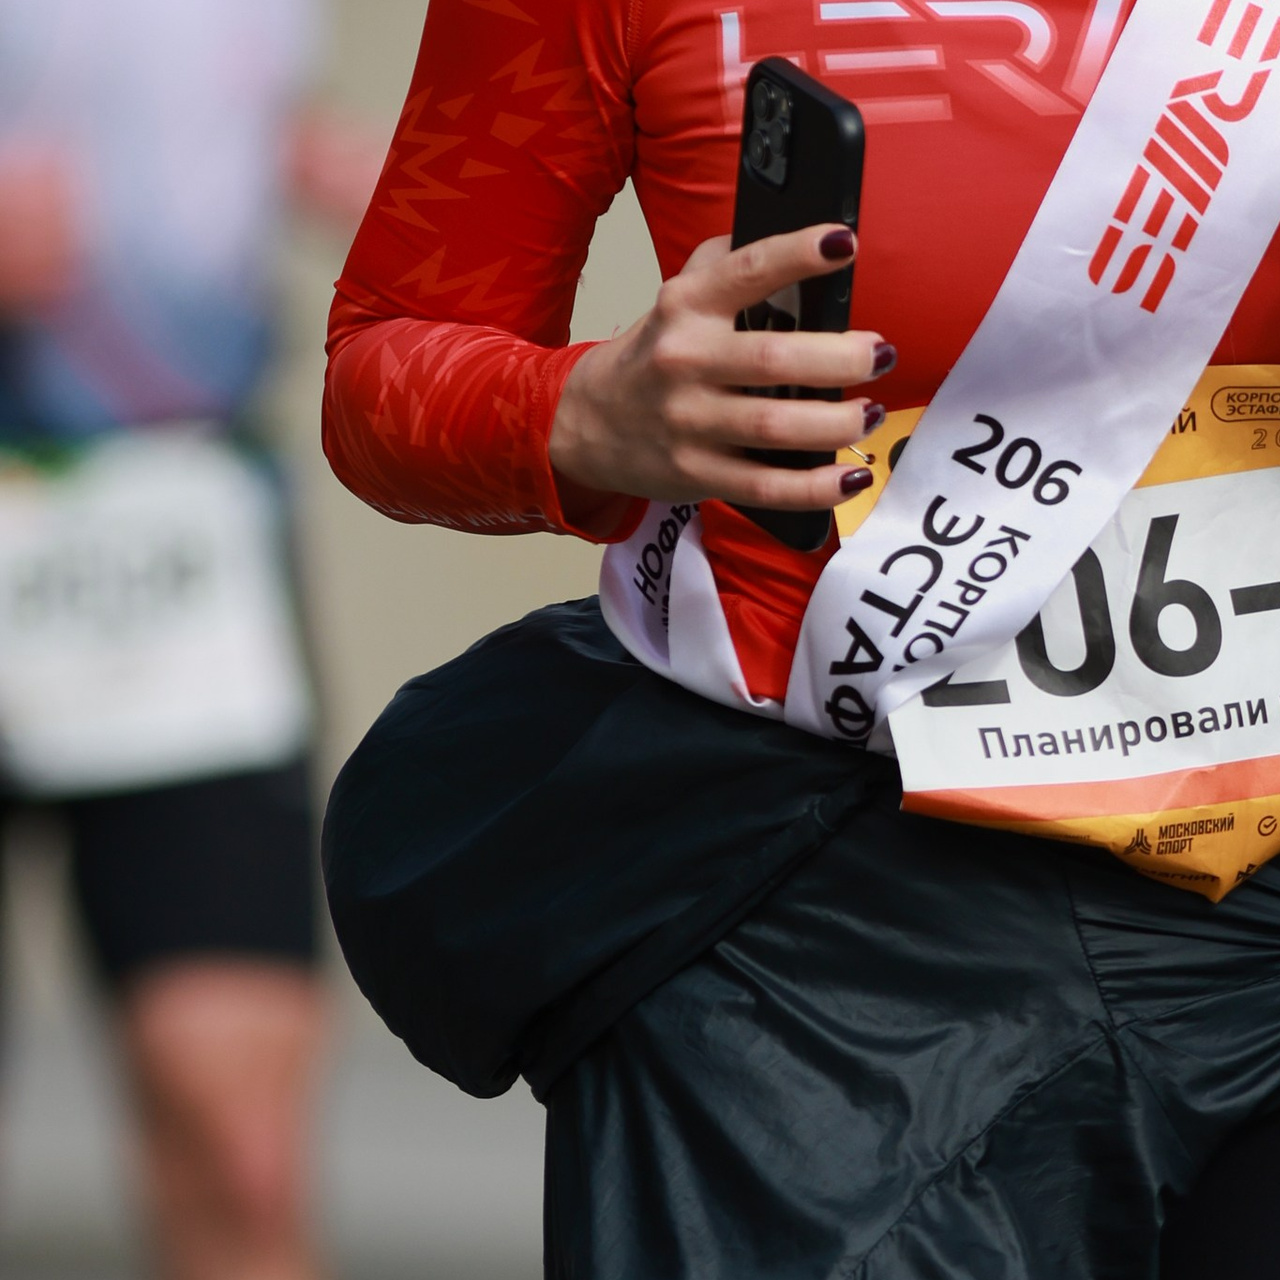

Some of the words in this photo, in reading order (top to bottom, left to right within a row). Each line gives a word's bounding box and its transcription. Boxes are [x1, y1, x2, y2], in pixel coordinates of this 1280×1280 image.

[951, 412, 1083, 506] 206
[633, 503, 700, 607] АФОН
[892, 524, 1032, 673] КОРПО
[824, 494, 986, 750] ЭСТАФ
[978, 693, 1269, 760] Планировали
[1156, 836, 1194, 856] СПОРТ
[1158, 813, 1235, 840] МОСКОВСКИЙ
